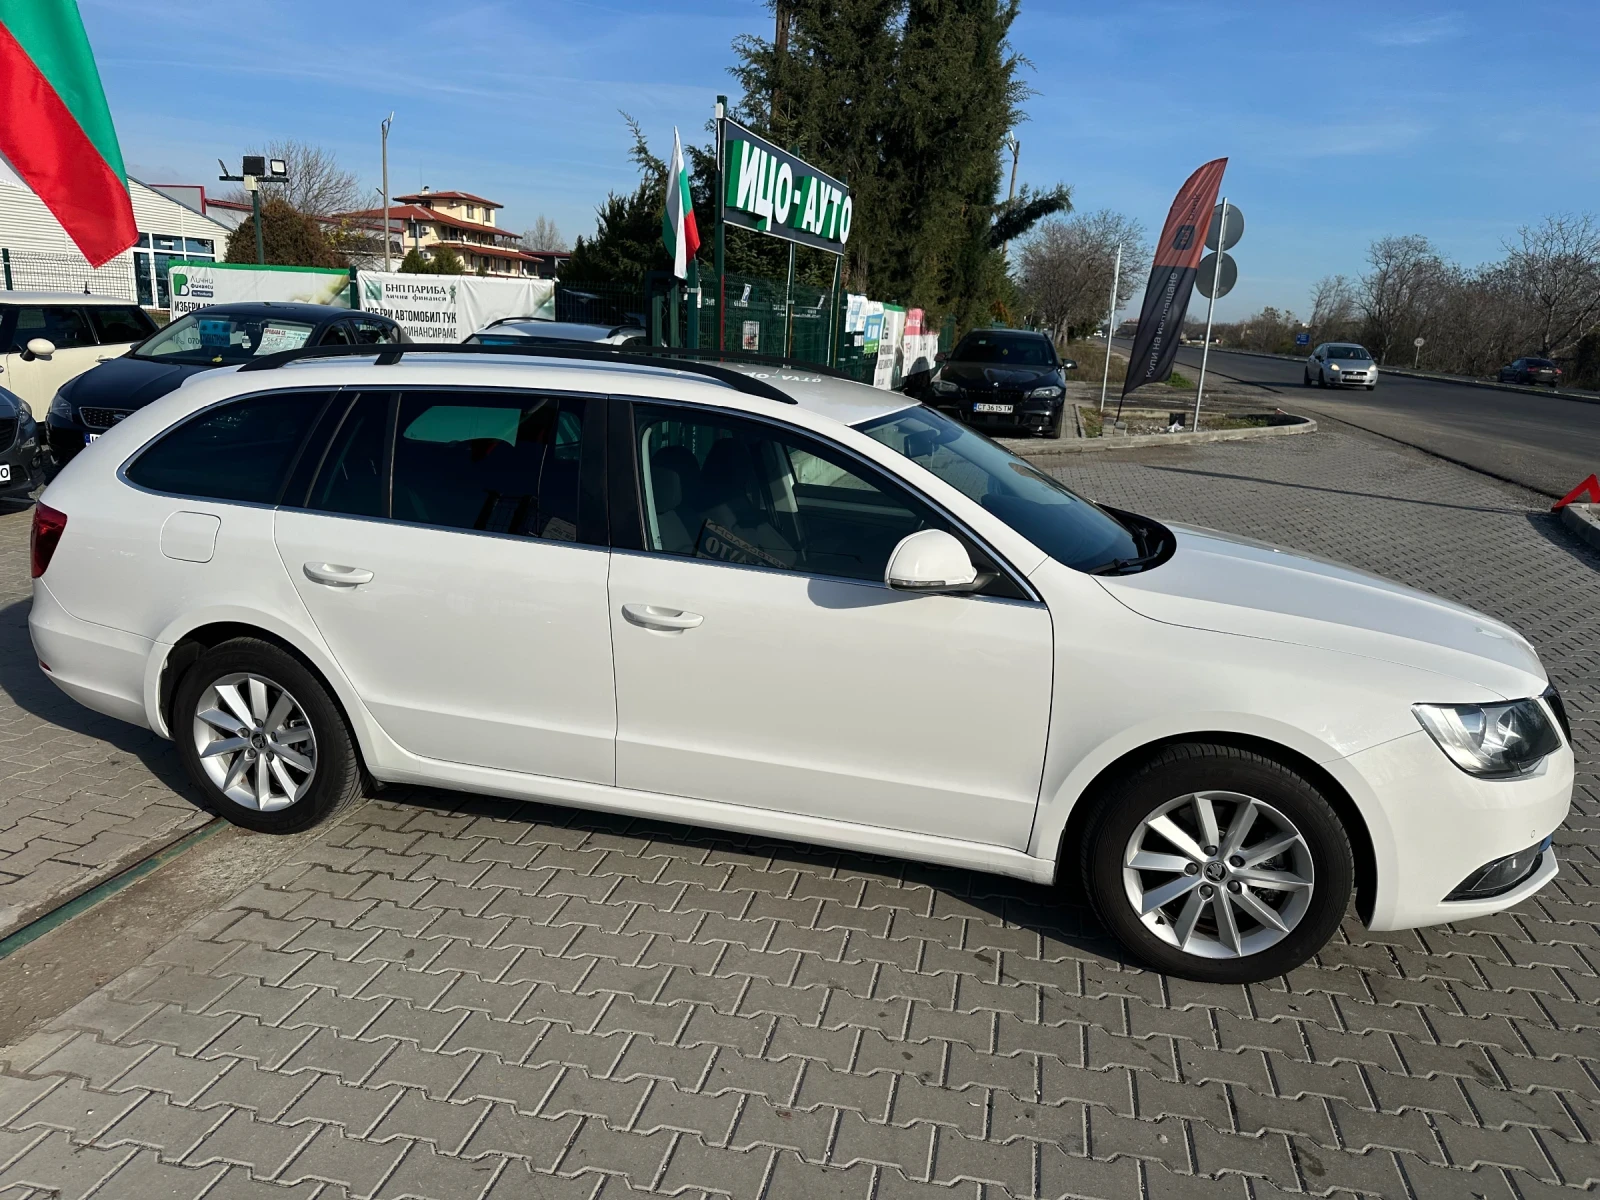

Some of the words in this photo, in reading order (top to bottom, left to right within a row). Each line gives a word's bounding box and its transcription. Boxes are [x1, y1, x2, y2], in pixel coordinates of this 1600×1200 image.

[736, 140, 852, 244] ИЦО-АУТО
[385, 283, 406, 293] БНП
[407, 285, 447, 295] ПАРИБА
[412, 294, 447, 302] финанси
[174, 300, 201, 313] ИЗБЕРИ
[395, 309, 441, 323] АВТОМОБИЛ
[442, 312, 457, 324] ТУК
[1146, 353, 1158, 378] Купи
[1152, 334, 1162, 351] на
